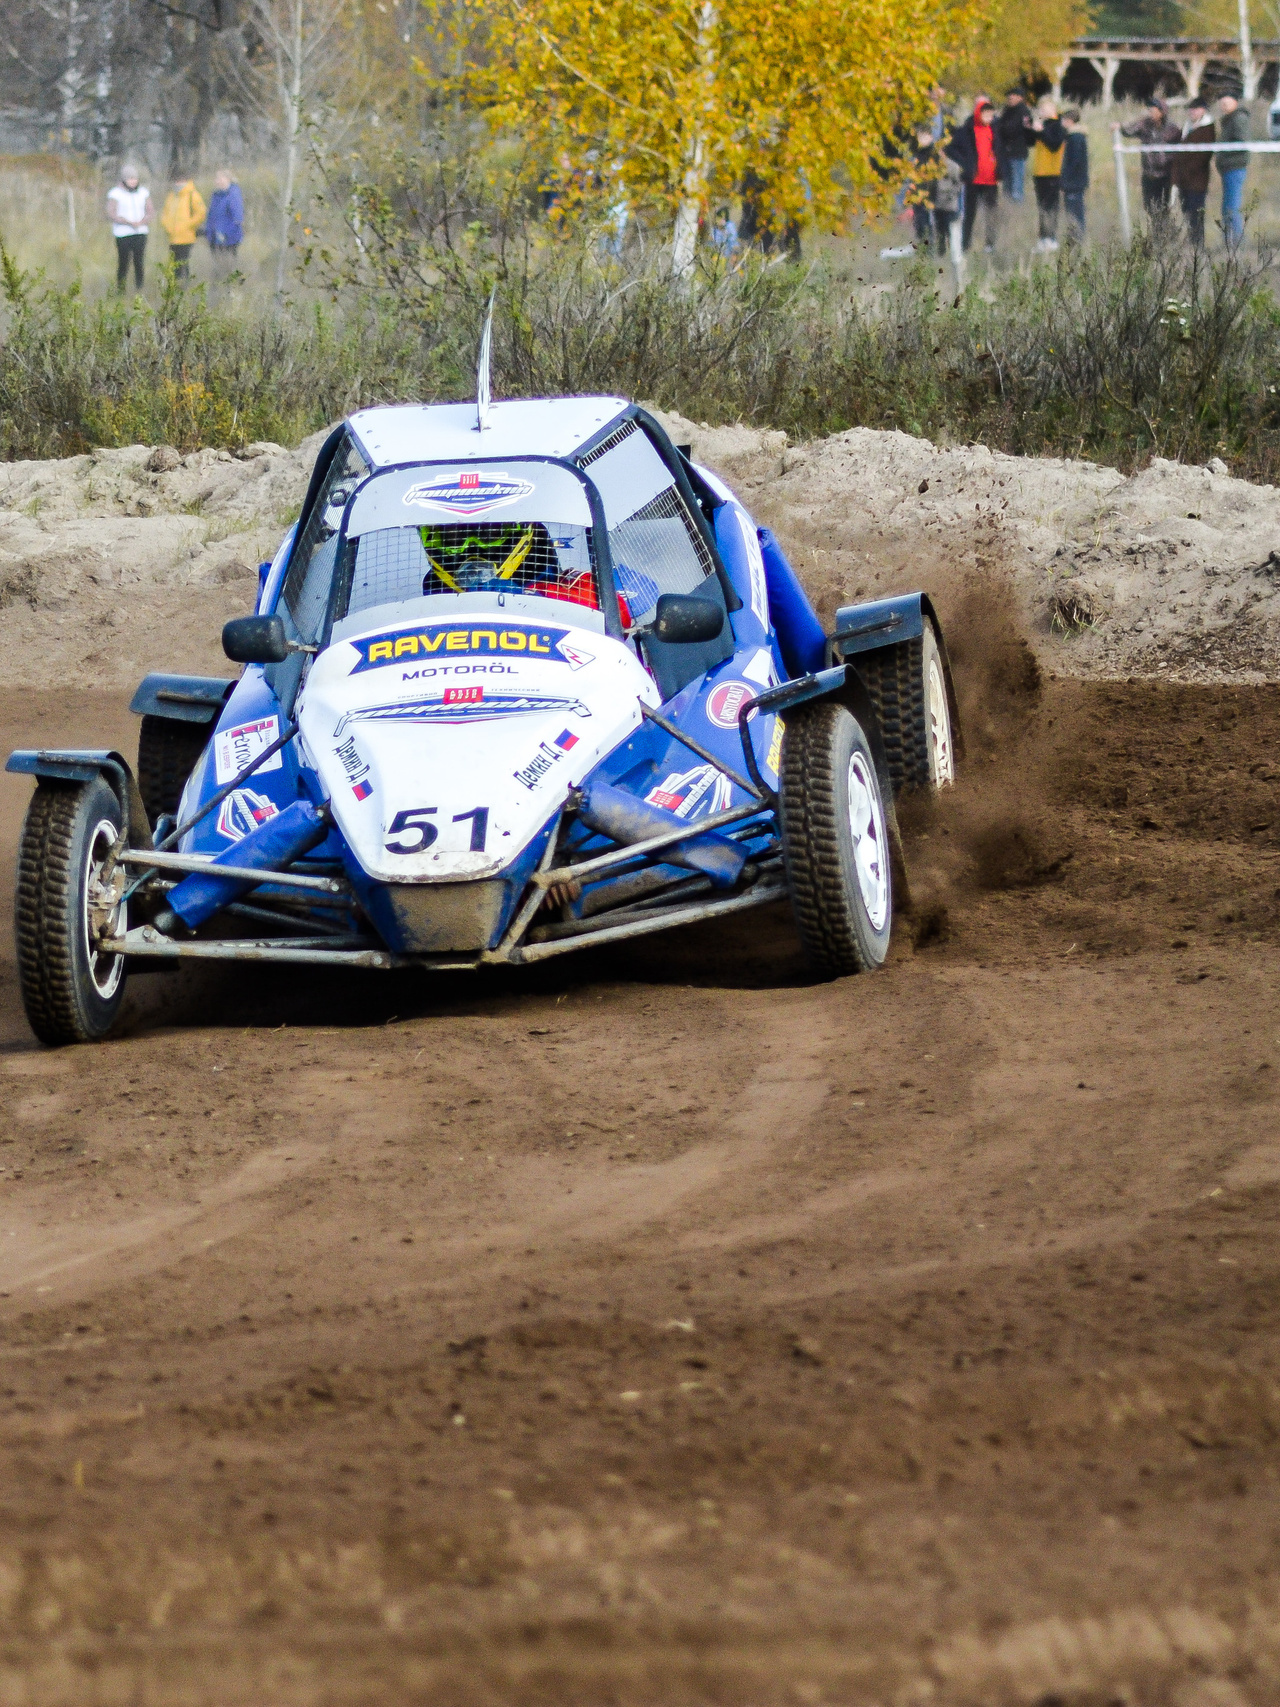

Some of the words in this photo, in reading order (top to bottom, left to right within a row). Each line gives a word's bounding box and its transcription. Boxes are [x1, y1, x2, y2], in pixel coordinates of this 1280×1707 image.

[369, 630, 551, 662] RAVENOL
[402, 662, 520, 681] MOTORÖL
[332, 736, 362, 773] Демин
[513, 754, 553, 791] Демин
[539, 741, 564, 762] Д.
[346, 764, 370, 784] Д.
[384, 806, 490, 855] 51
